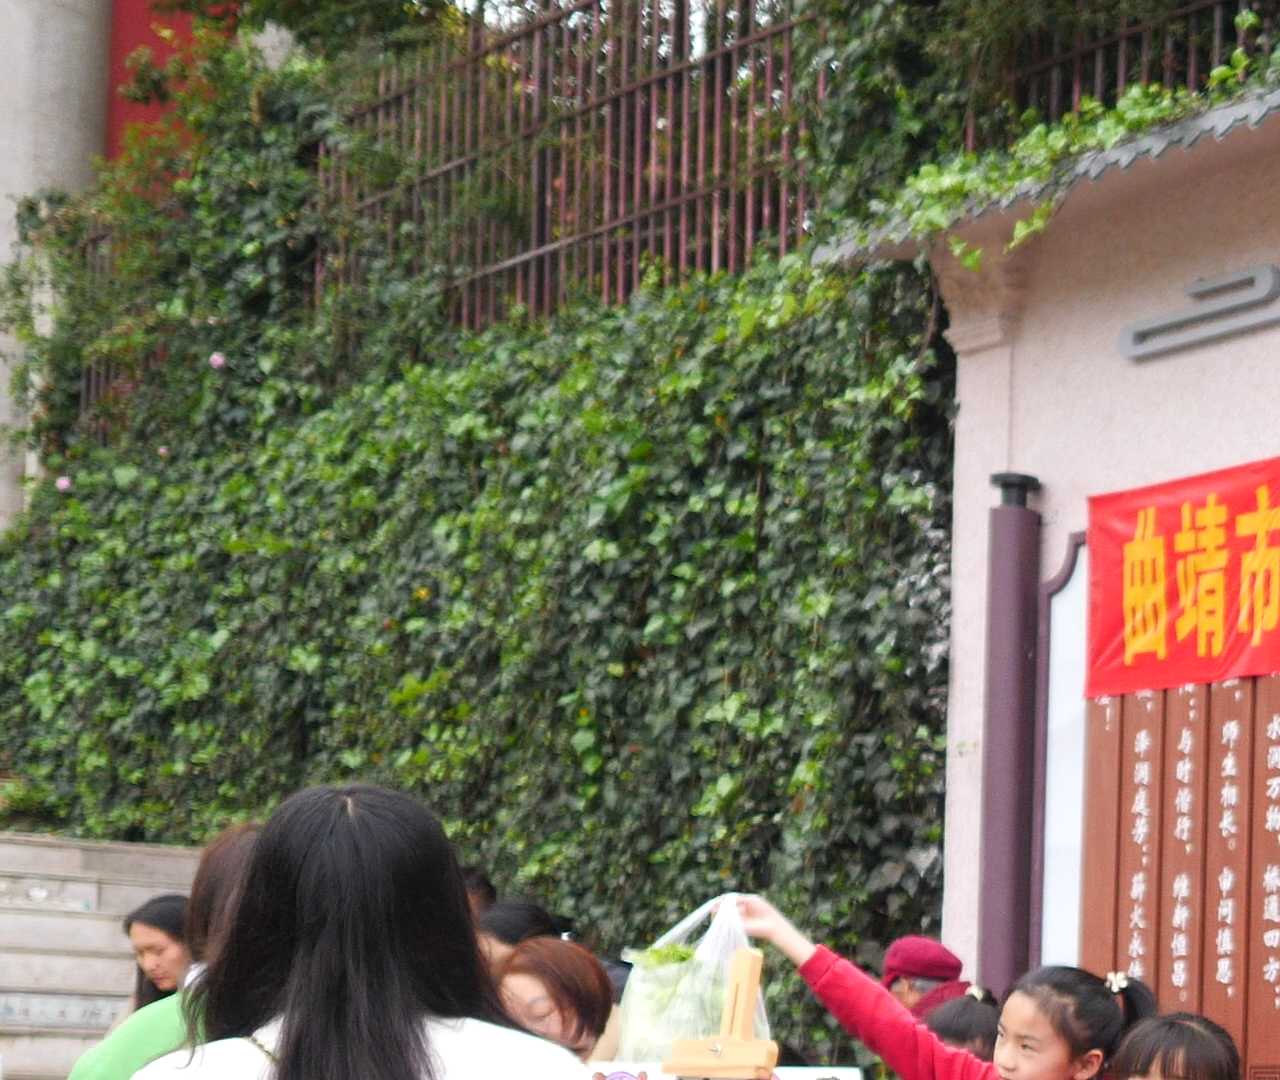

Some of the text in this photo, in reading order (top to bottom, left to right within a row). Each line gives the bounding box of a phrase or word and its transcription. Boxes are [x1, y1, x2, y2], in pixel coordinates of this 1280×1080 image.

[1216, 679, 1241, 998] ，师生相长。审问慎思，
